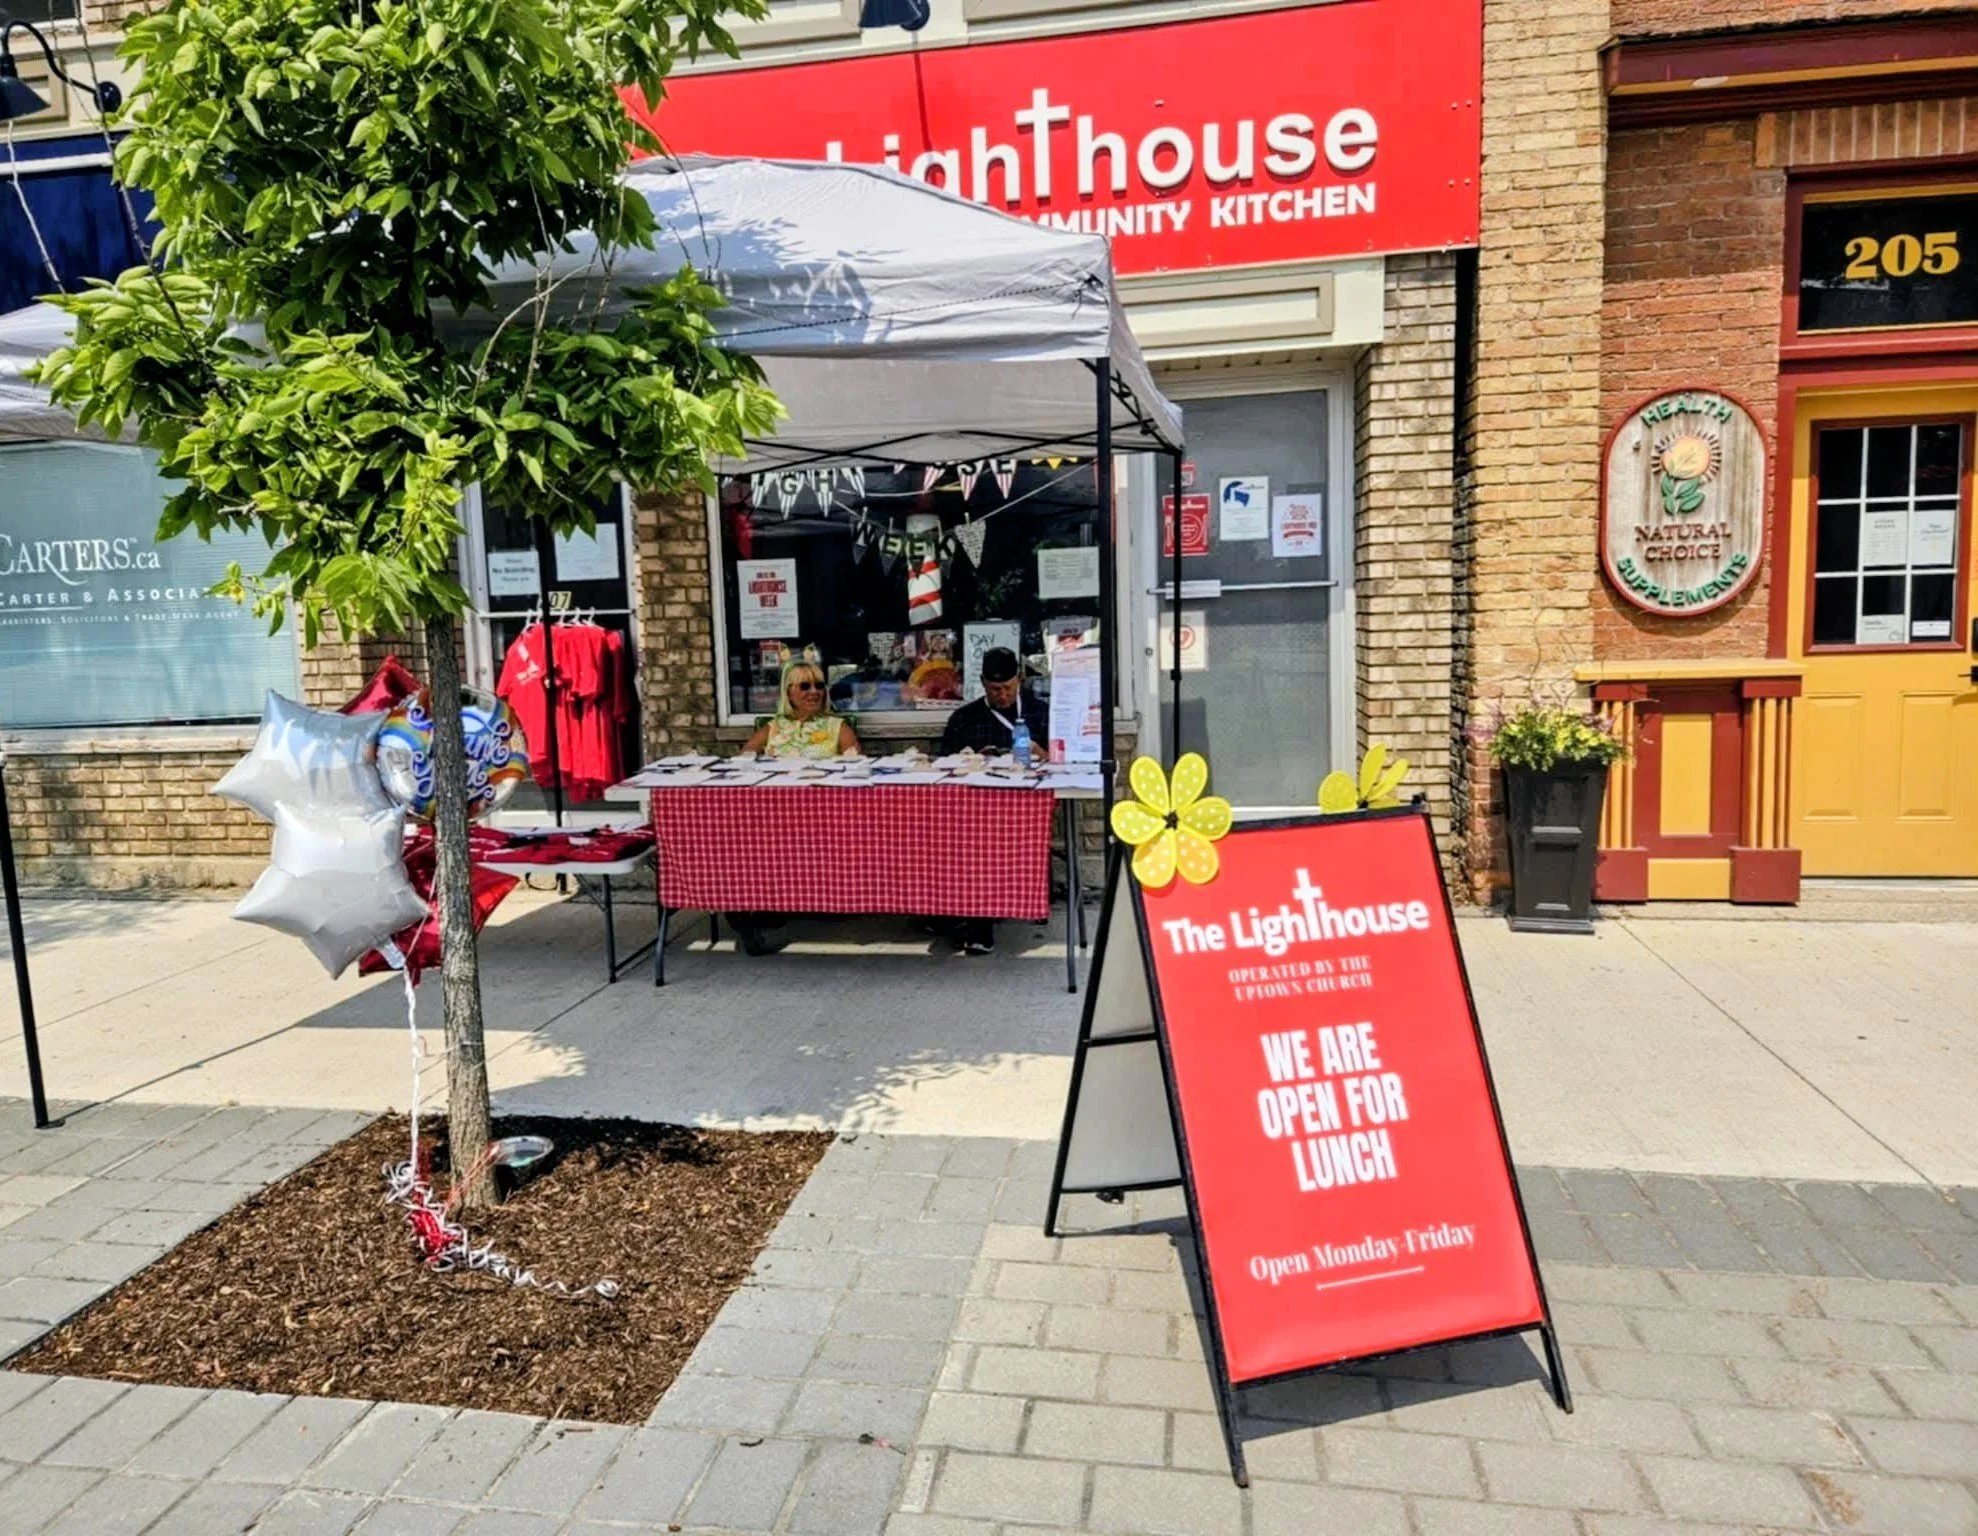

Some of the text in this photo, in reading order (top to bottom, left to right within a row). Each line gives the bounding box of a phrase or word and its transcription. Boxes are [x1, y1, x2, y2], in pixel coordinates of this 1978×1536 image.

[827, 88, 1378, 202] ighthouse
[1211, 182, 1376, 227] KITCHEN
[1845, 231, 1960, 280] 205
[1641, 400, 1731, 427] HEALTH
[1635, 522, 1732, 543] NATURAL
[1645, 543, 1721, 563] CHOICE
[82, 591, 94, 603] &
[1617, 552, 1748, 607] SUPPLEMENTS
[1162, 868, 1431, 957] The Lighthouse
[1228, 955, 1371, 983] OPERATED BY THE
[1234, 973, 1372, 1002] UPTOWN CHURCH
[1260, 1021, 1382, 1083] WE ARE
[1257, 1072, 1410, 1140] OPEN FOR
[1291, 1127, 1398, 1193] LUNCH
[1249, 1254, 1311, 1286] Open
